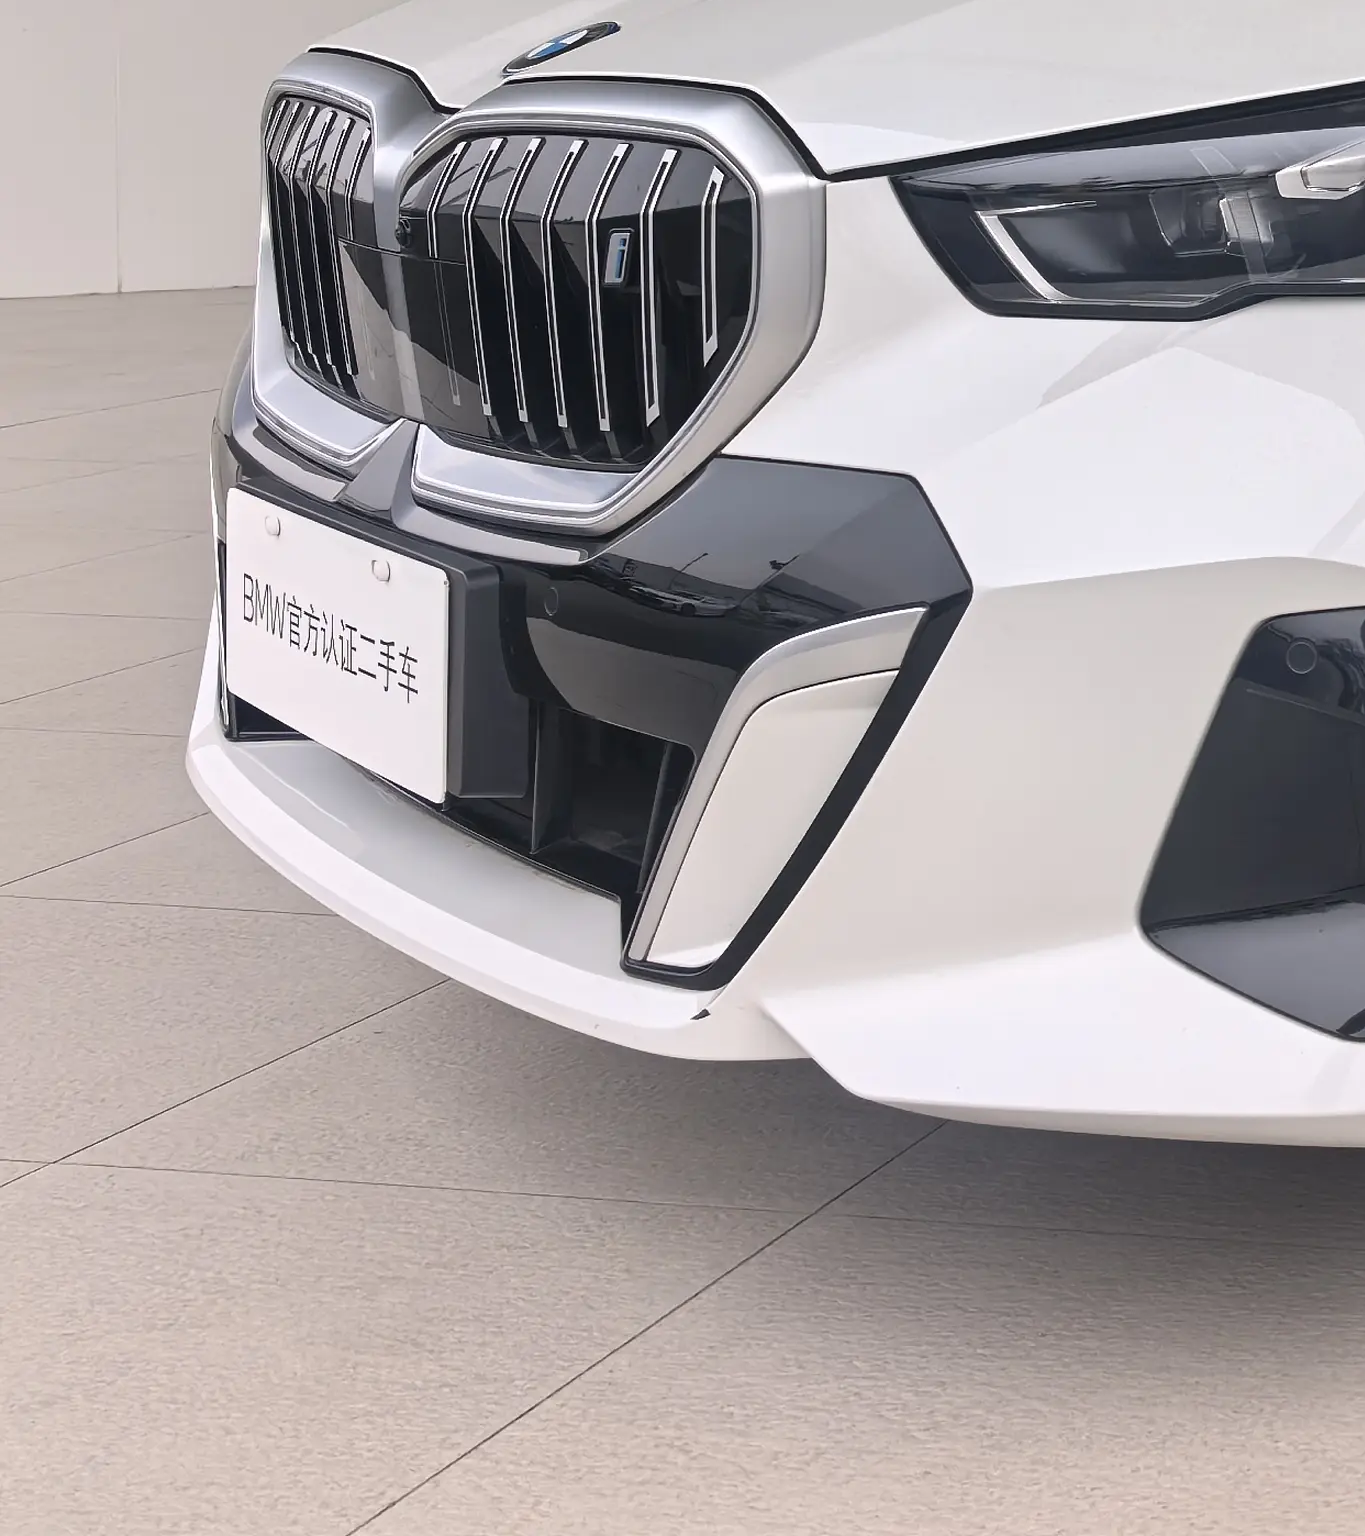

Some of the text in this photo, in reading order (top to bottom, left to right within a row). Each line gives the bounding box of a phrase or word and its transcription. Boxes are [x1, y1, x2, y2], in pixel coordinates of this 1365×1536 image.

[243, 573, 419, 704] BMW官方认证二手车
